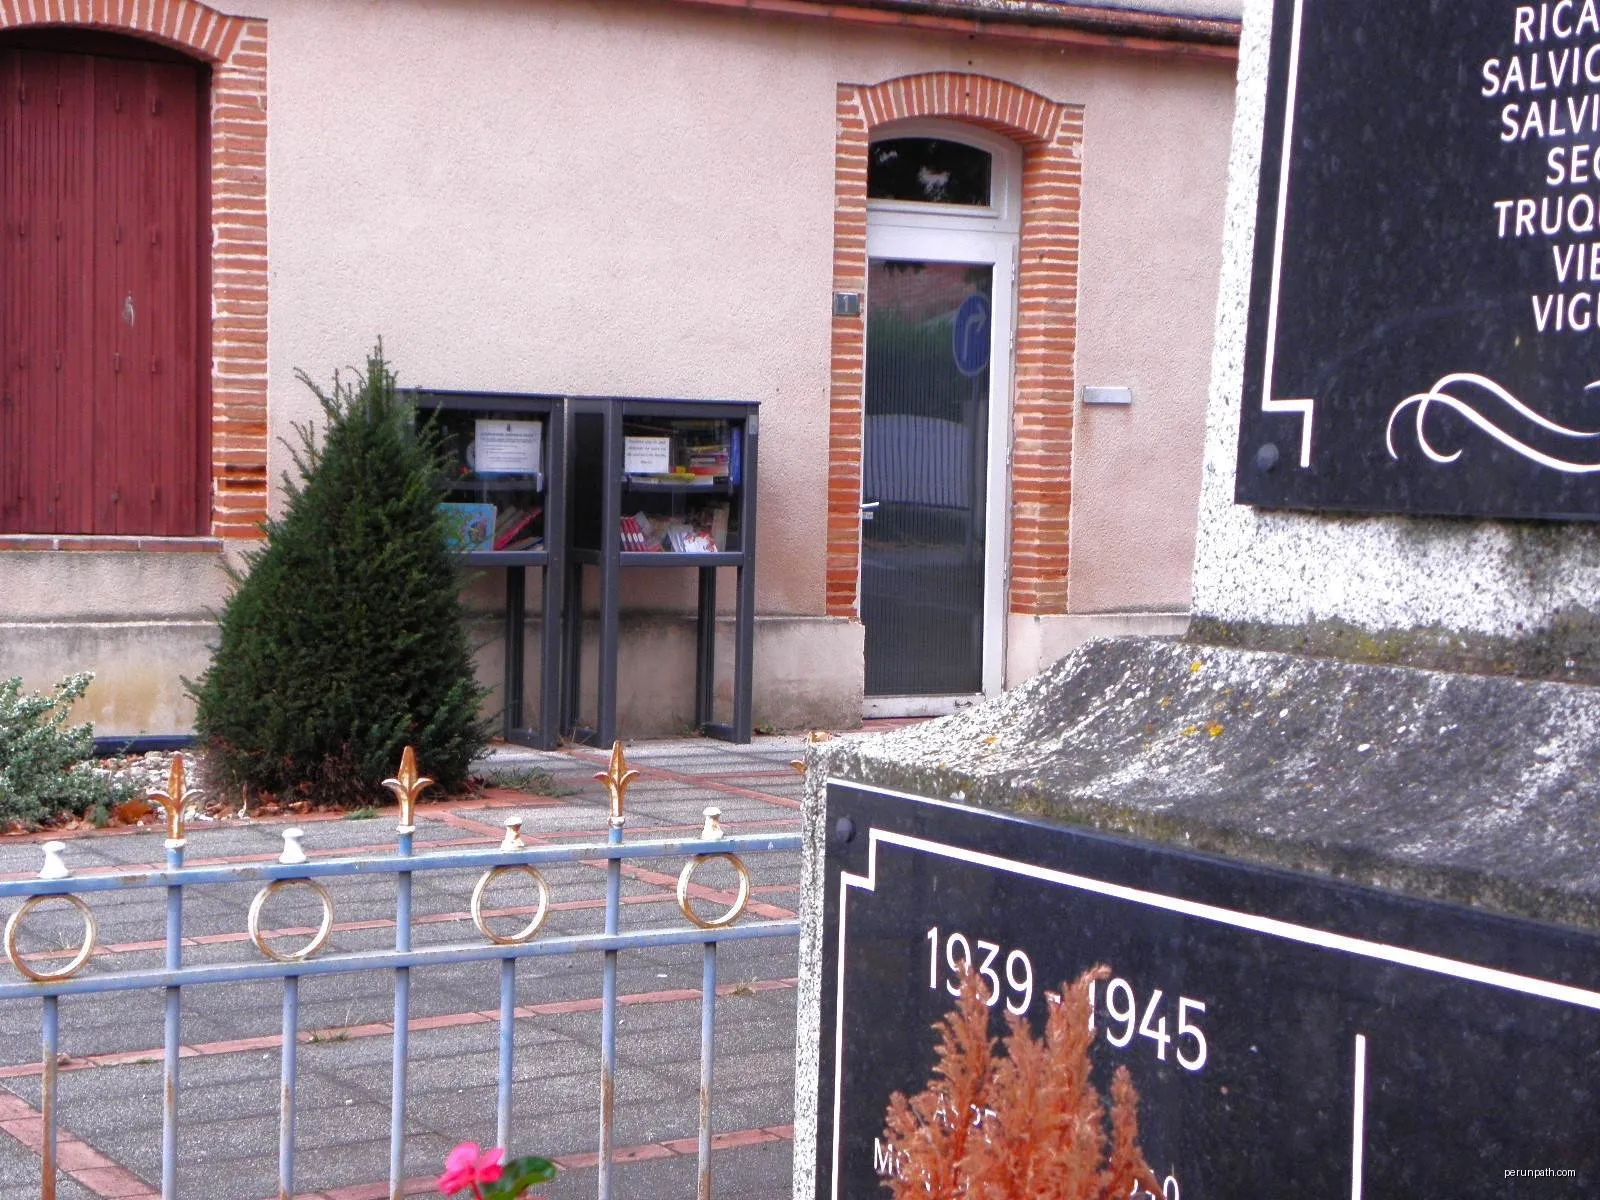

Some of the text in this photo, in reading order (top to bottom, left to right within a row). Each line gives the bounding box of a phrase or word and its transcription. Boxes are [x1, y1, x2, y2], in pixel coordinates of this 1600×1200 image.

[1500, 93, 1600, 142] SALVI
[1493, 193, 1600, 238] TRUQ
[1532, 291, 1600, 332] VIG
[927, 926, 1033, 1016] 1939
[1086, 977, 1207, 1071] 1945
